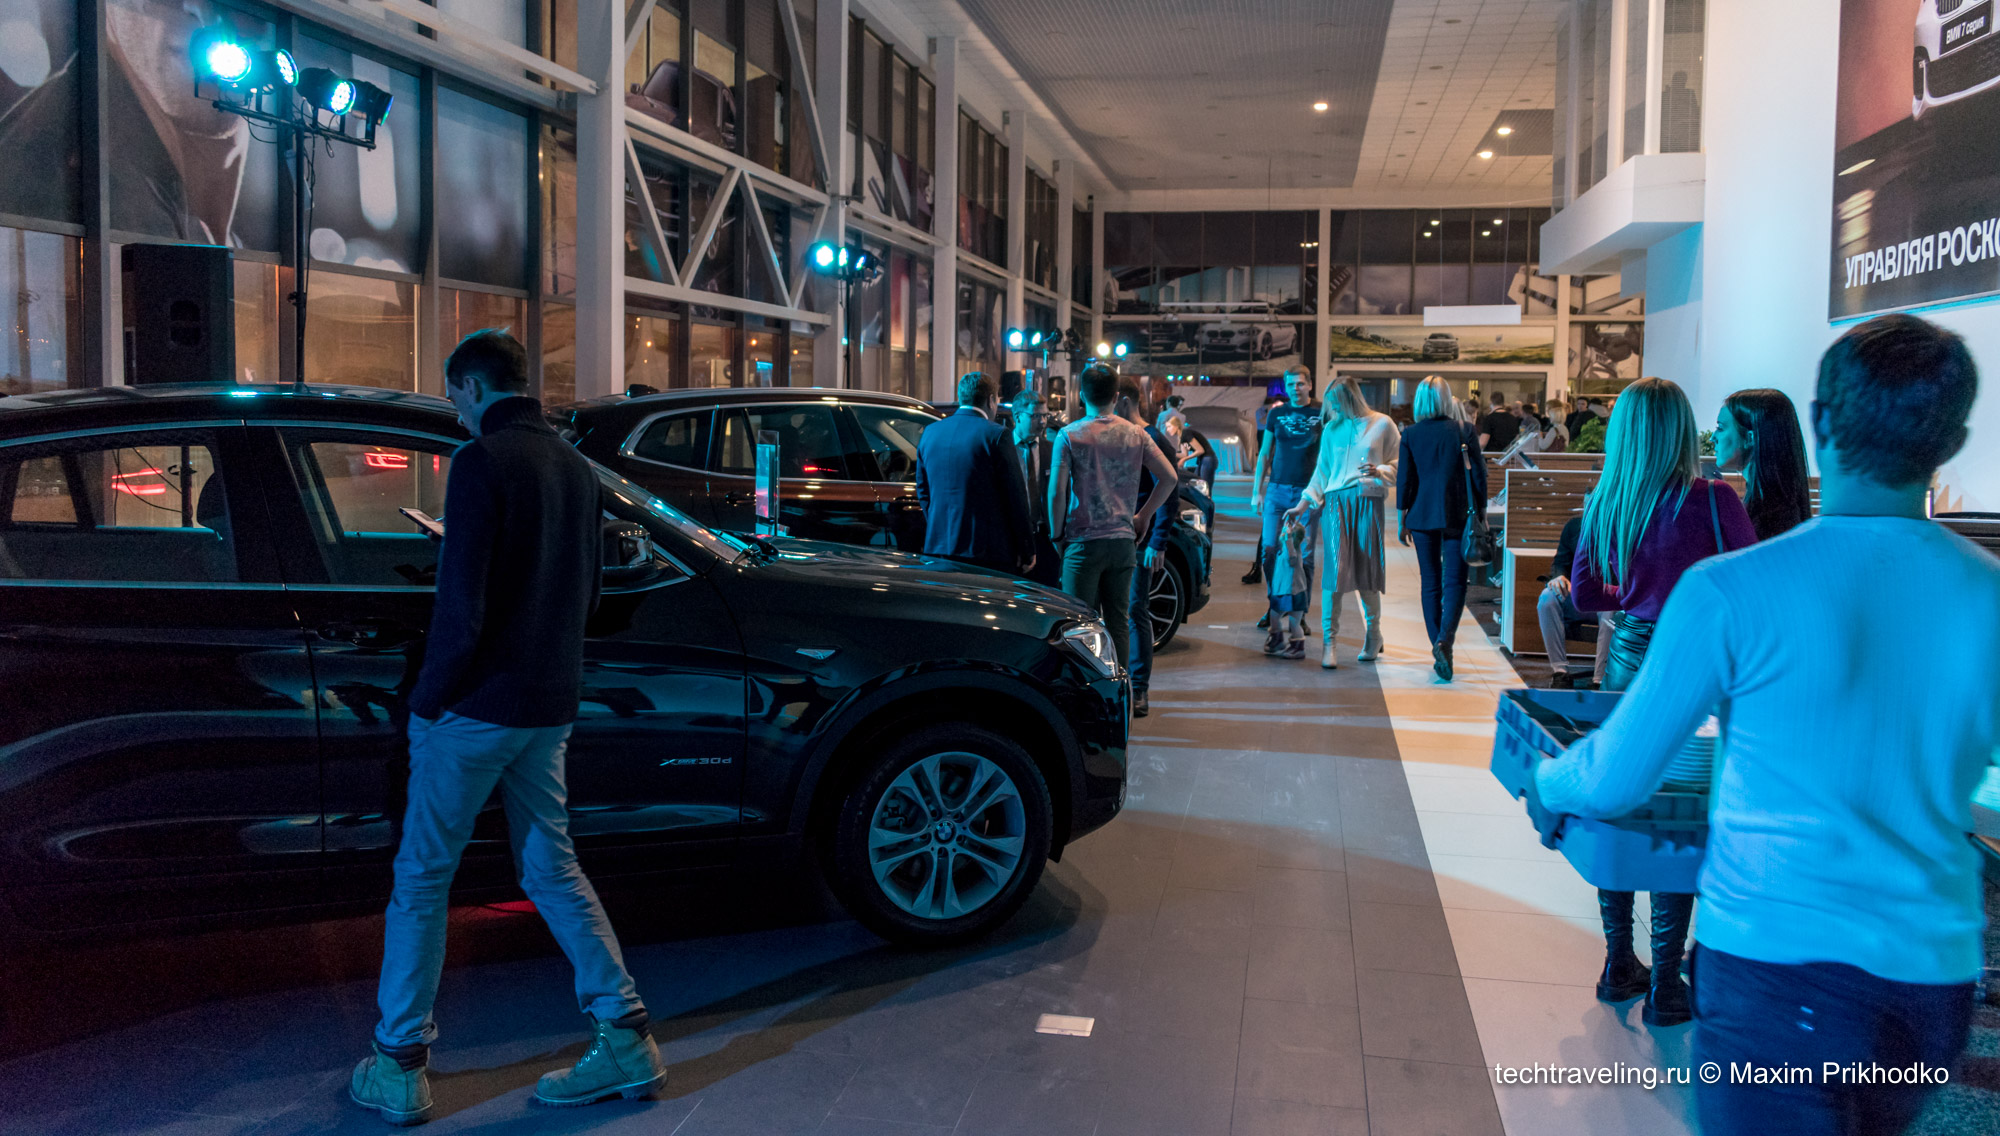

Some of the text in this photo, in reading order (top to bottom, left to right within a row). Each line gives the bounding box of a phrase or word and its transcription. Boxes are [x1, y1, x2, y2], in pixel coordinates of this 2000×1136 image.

[1946, 16, 1985, 44] BMW 7 серия
[1844, 234, 1935, 289] УПРАВЛЯЯ
